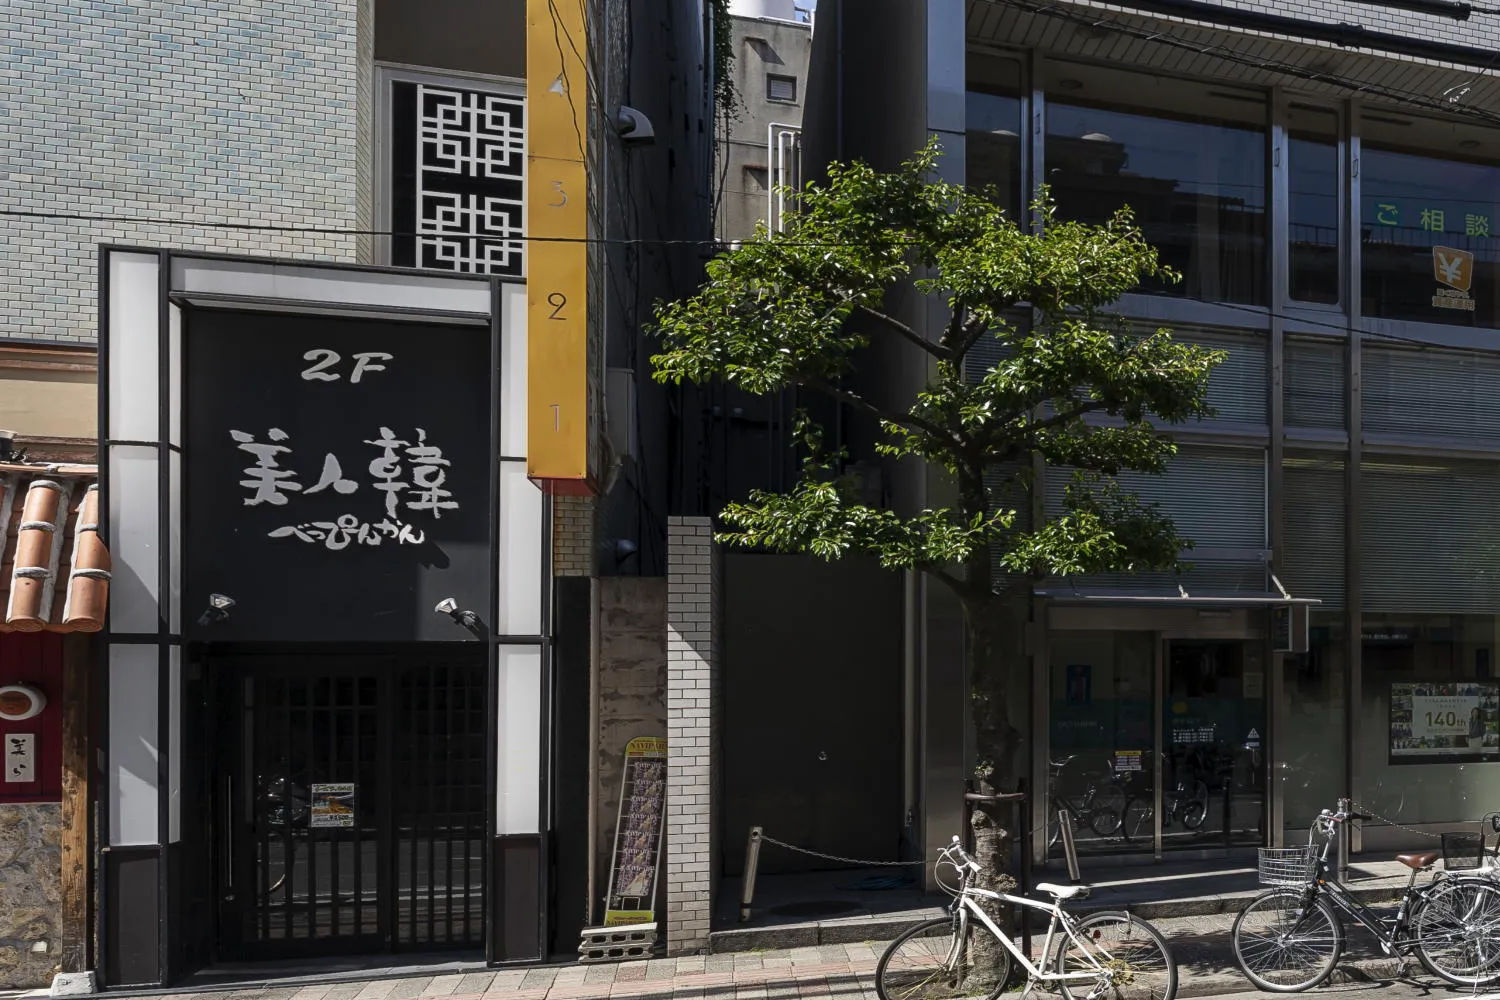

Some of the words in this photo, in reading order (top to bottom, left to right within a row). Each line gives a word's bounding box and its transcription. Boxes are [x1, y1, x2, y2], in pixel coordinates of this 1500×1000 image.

[547, 180, 568, 208] 3
[547, 292, 567, 320] 2
[301, 349, 394, 384] 2F
[549, 404, 560, 433] 1
[229, 427, 459, 518] 美人韓
